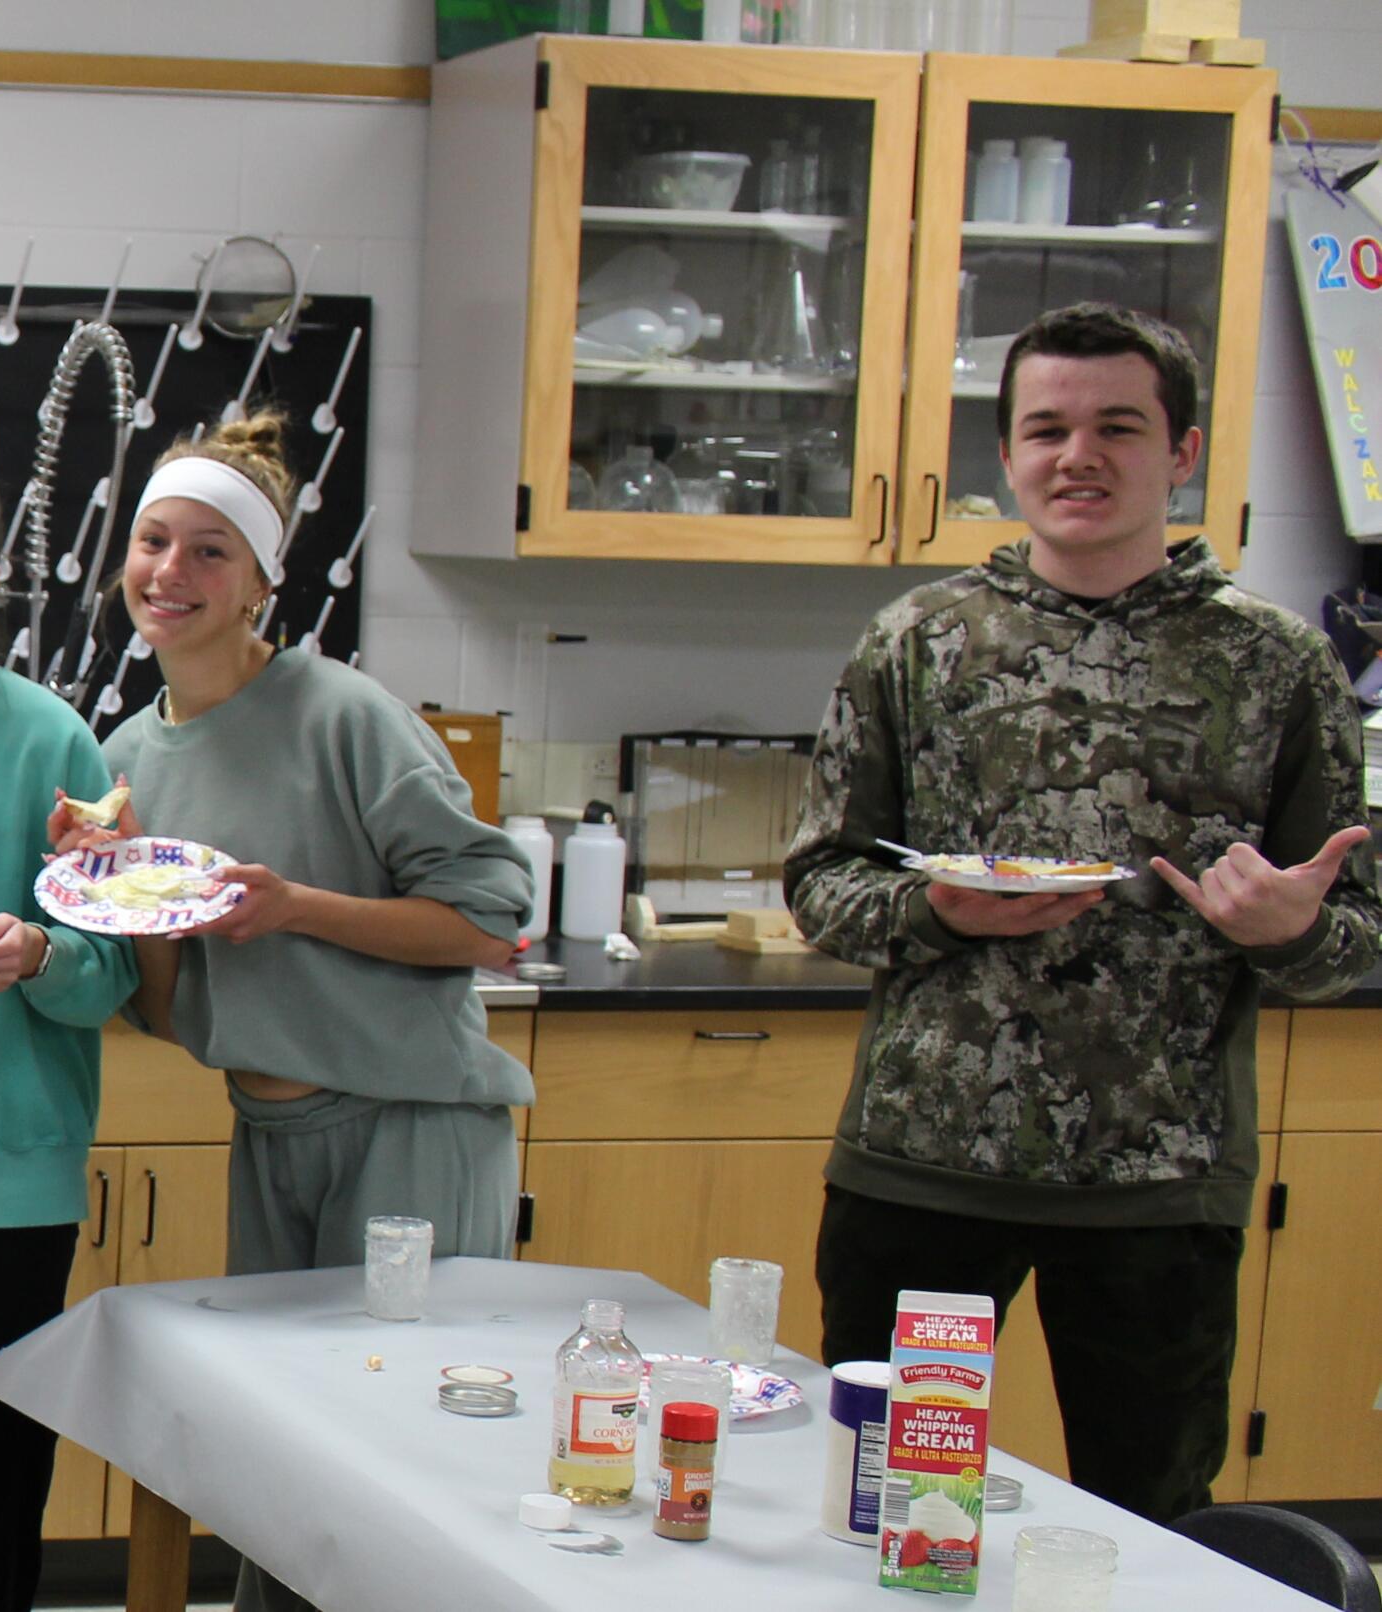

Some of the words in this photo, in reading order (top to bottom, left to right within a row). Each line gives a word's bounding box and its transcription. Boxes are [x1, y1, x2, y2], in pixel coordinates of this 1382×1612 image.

[1334, 348, 1382, 502] WALCZAK
[913, 1320, 978, 1332] WHIPPING
[925, 1315, 967, 1325] HEAVY
[912, 1328, 978, 1342] CREAM
[903, 1365, 948, 1378] Friendly
[949, 1366, 982, 1384] Farms
[916, 1408, 962, 1422] HEAVY
[593, 1428, 624, 1438] CORN
[903, 1419, 975, 1435] WHIPPING
[902, 1431, 974, 1451] CREAM
[893, 1446, 913, 1458] GRADE
[921, 1450, 940, 1461] ULTRA
[942, 1451, 983, 1464] PASTEURIZED
